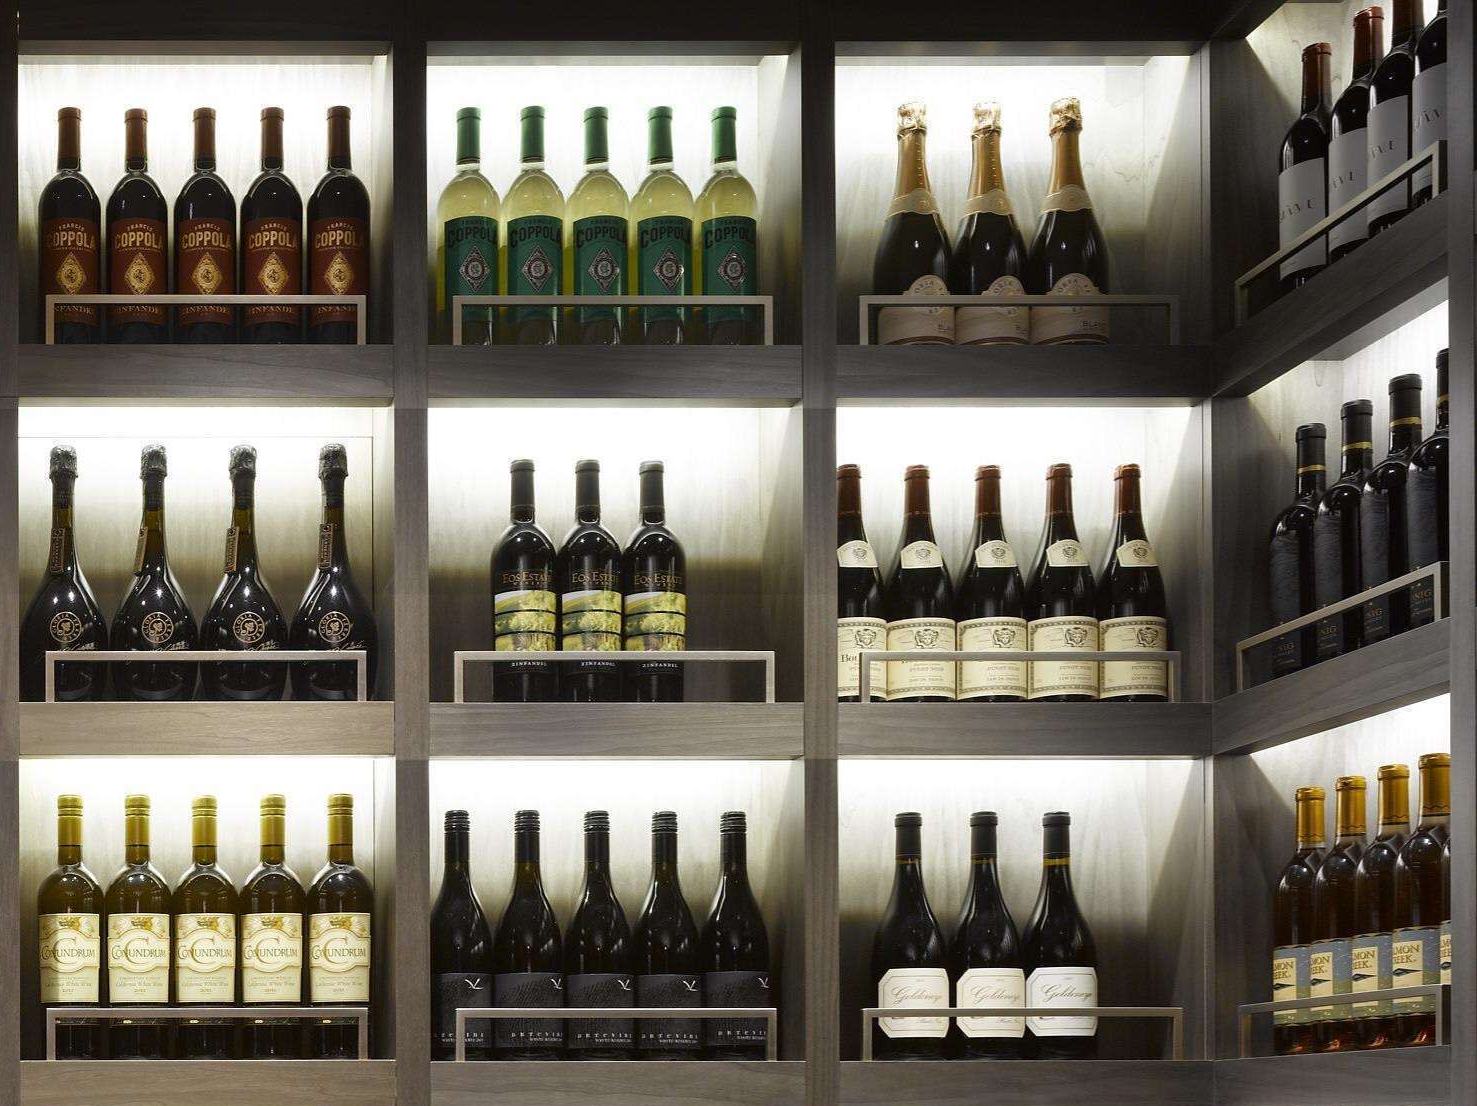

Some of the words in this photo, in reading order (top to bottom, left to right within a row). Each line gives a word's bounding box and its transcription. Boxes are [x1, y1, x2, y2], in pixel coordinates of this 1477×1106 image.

[41, 945, 95, 960] CONUNDRUM
[111, 945, 166, 960] CONUNDRUM
[178, 945, 232, 960] CONUNDRUM
[244, 944, 298, 959] CONUNDRUM
[311, 944, 367, 959] CONUNDRUM
